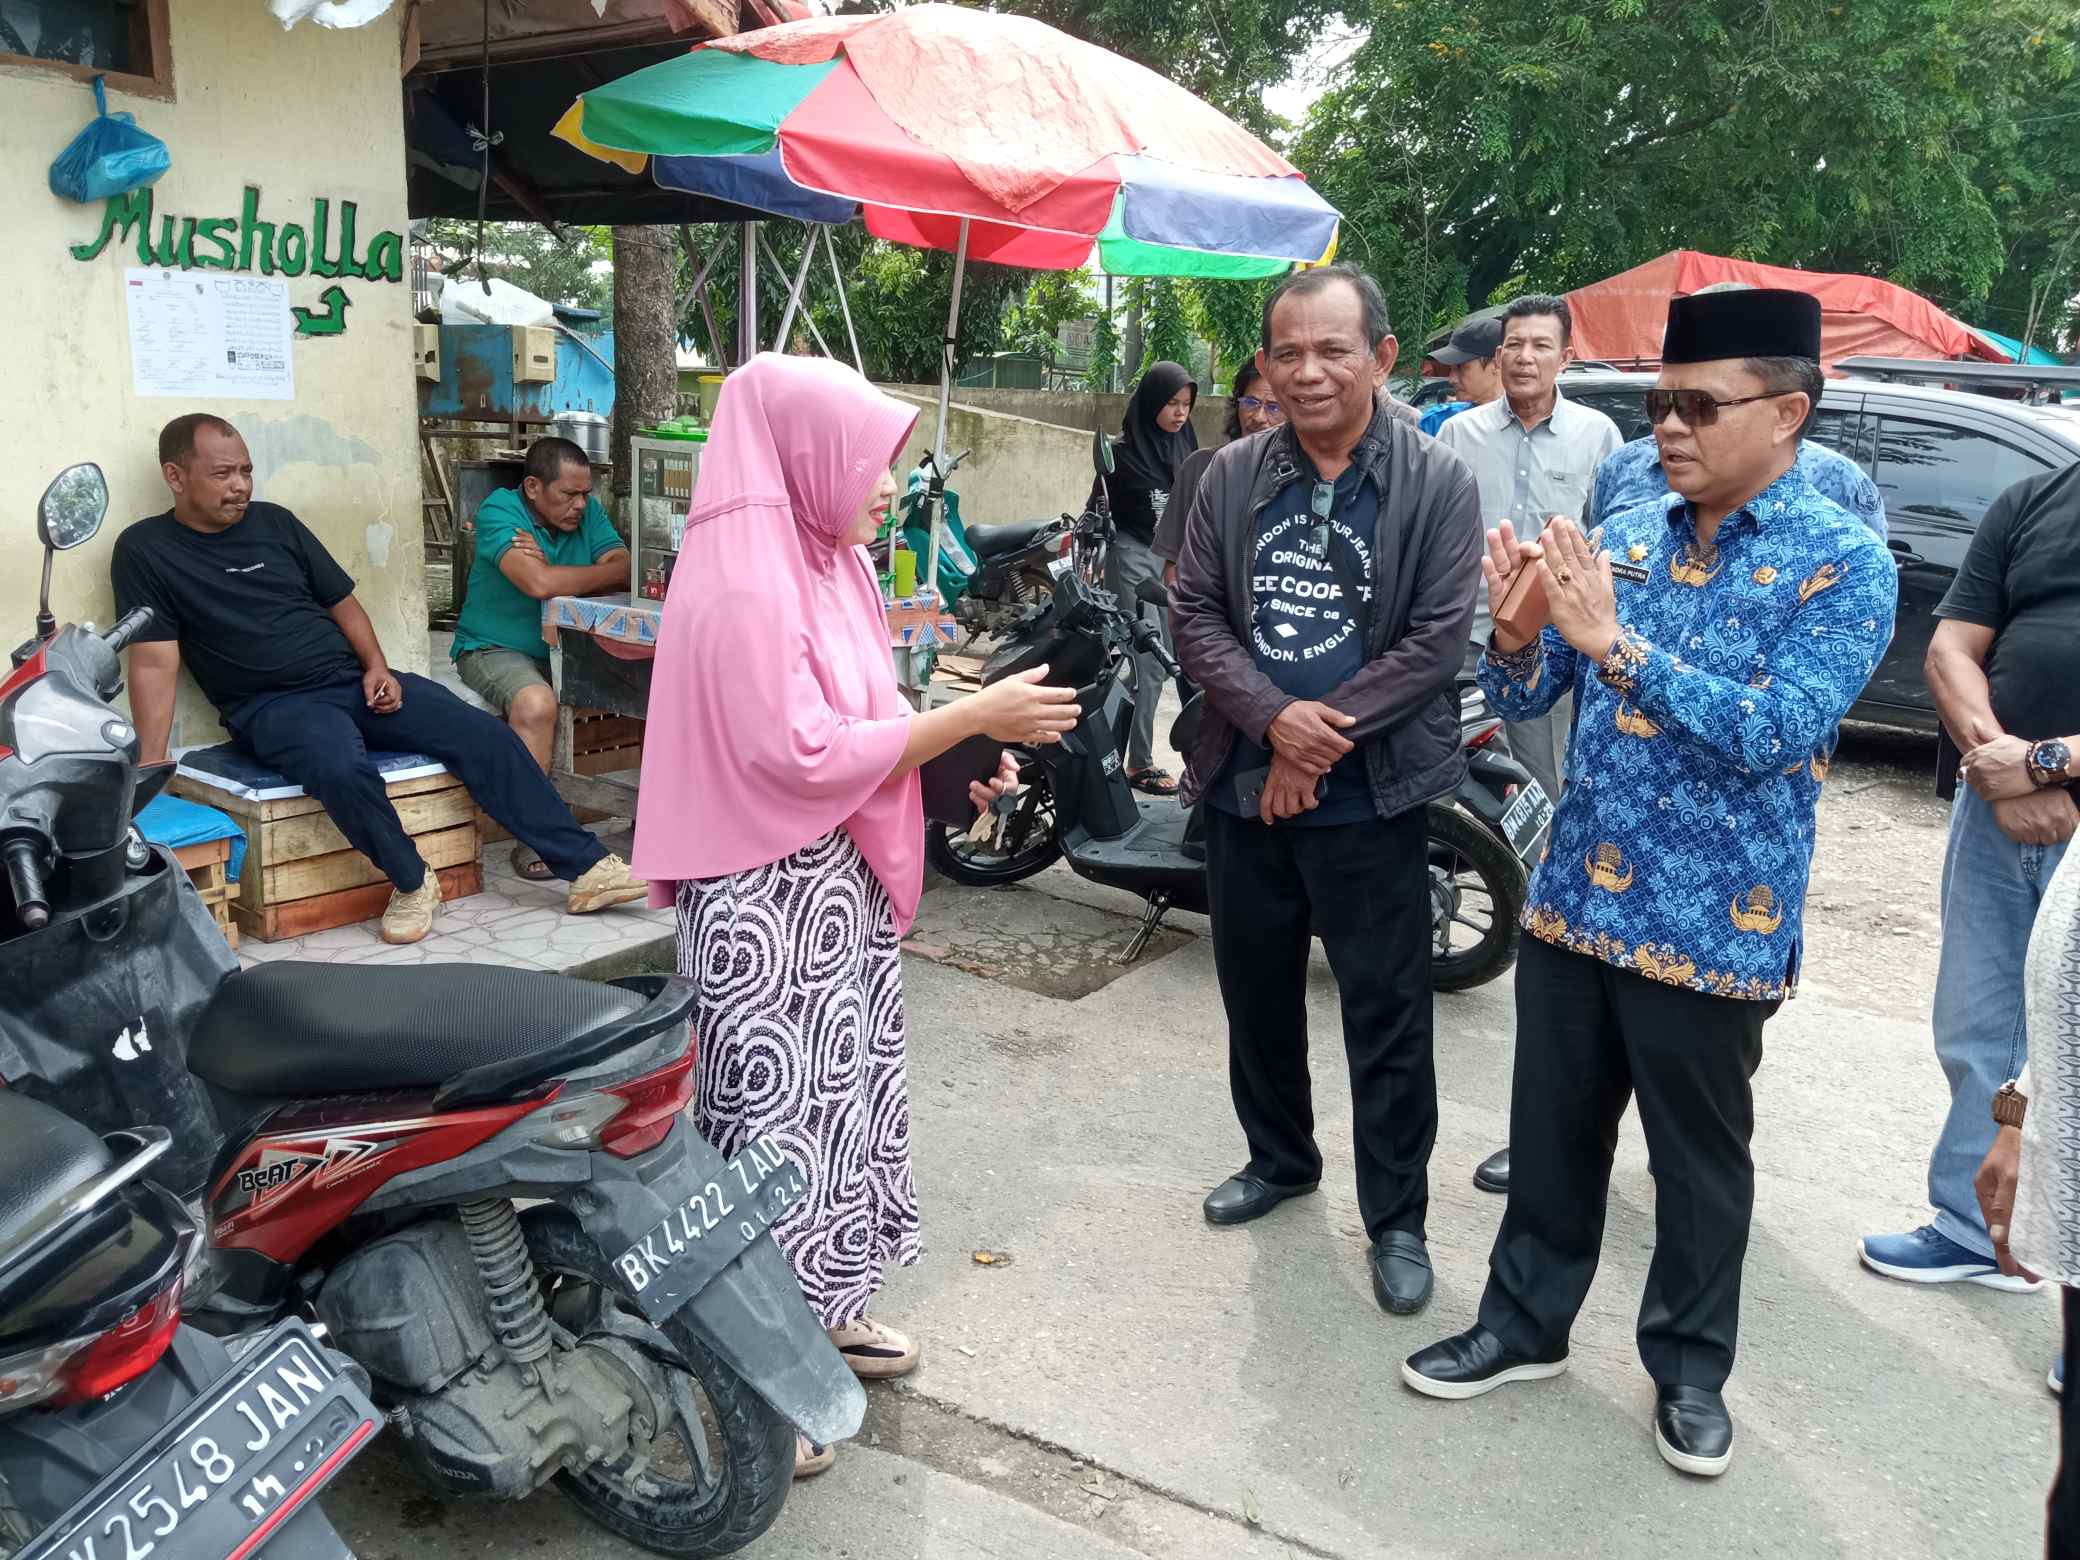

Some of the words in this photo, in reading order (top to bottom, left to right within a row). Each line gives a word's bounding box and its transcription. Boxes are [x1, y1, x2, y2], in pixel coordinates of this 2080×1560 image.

[69, 185, 404, 284] Musholla
[1294, 514, 1308, 525] IS
[1299, 538, 1323, 555] THE
[1271, 550, 1334, 573] ORIGINA
[1252, 575, 1279, 592] EE
[1270, 598, 1317, 618] SINCE
[1303, 618, 1357, 660] ENGLA
[728, 1134, 786, 1194] ZAD
[236, 1355, 326, 1451] JAN
